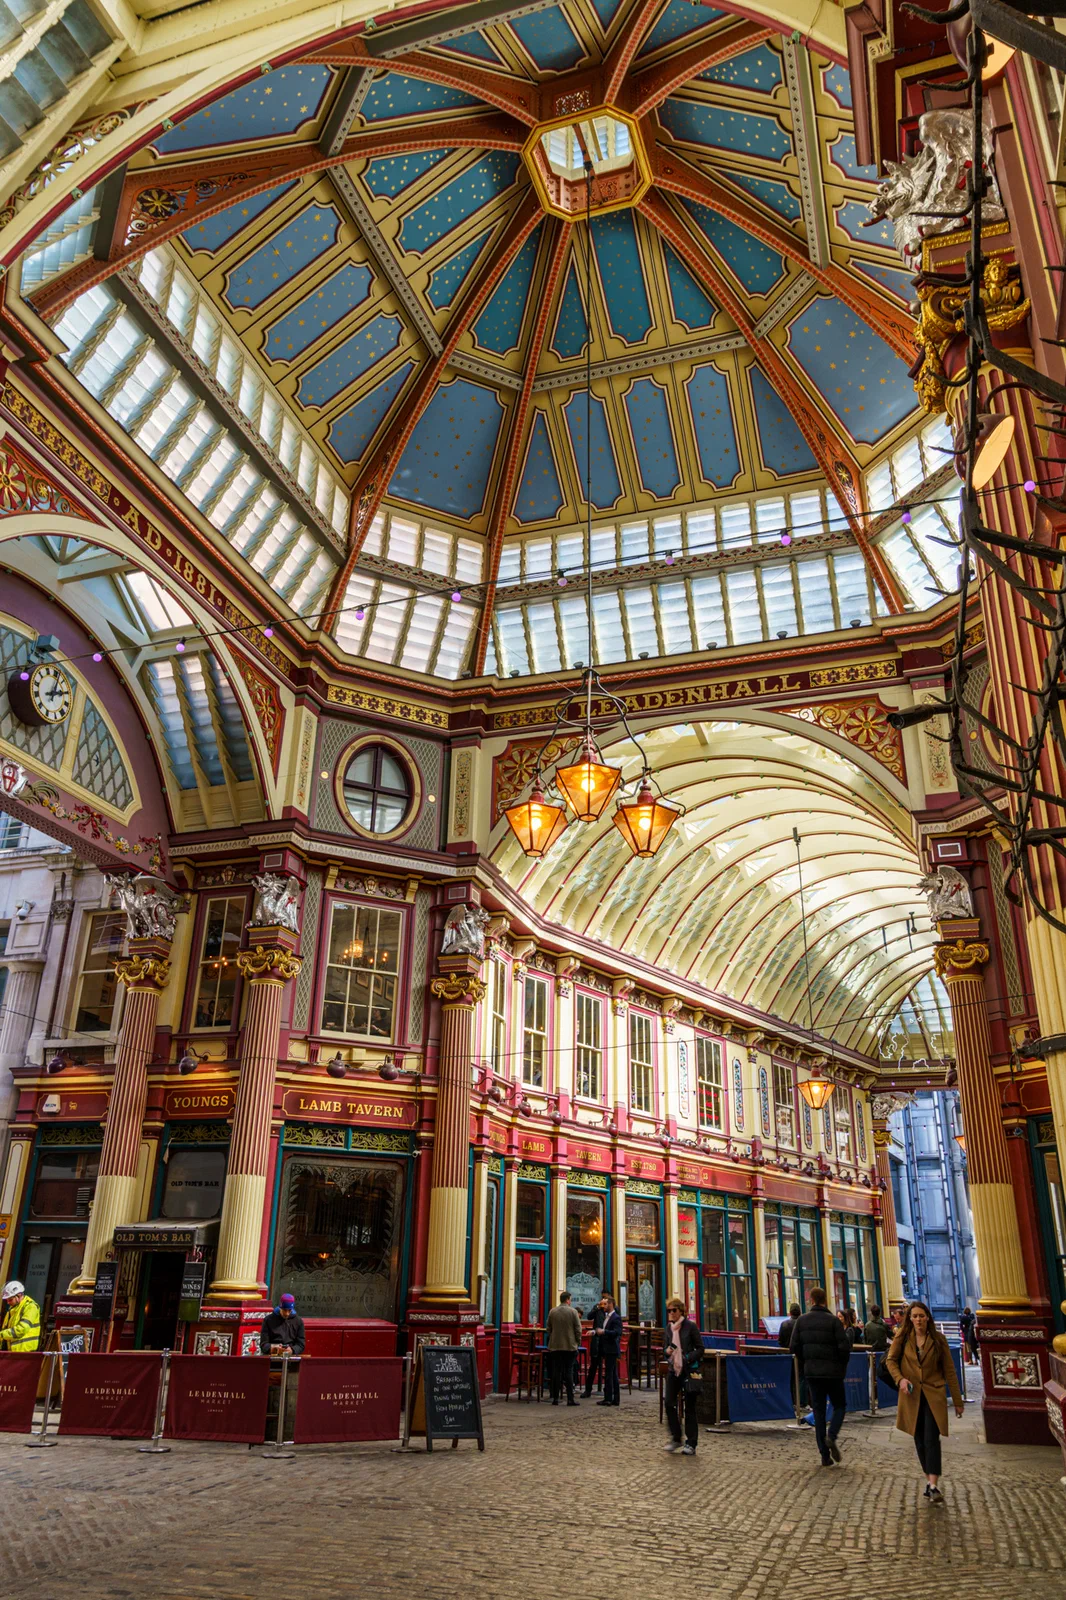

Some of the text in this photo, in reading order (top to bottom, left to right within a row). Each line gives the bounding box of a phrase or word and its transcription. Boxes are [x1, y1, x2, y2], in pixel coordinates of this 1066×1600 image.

[578, 674, 801, 718] LEADENHALL
[173, 1095, 229, 1108] YOUNGS
[299, 1098, 404, 1118] LAMB TAVERN
[489, 1130, 506, 1145] OUNGS
[522, 1140, 545, 1153] LAMB
[575, 1149, 602, 1162] TAVERN
[116, 1233, 191, 1242] OLD TOM'S BAR
[84, 1387, 138, 1395] LEADENHALL
[188, 1390, 246, 1399] LEADENHALL
[320, 1391, 379, 1400] LEADENHALL
